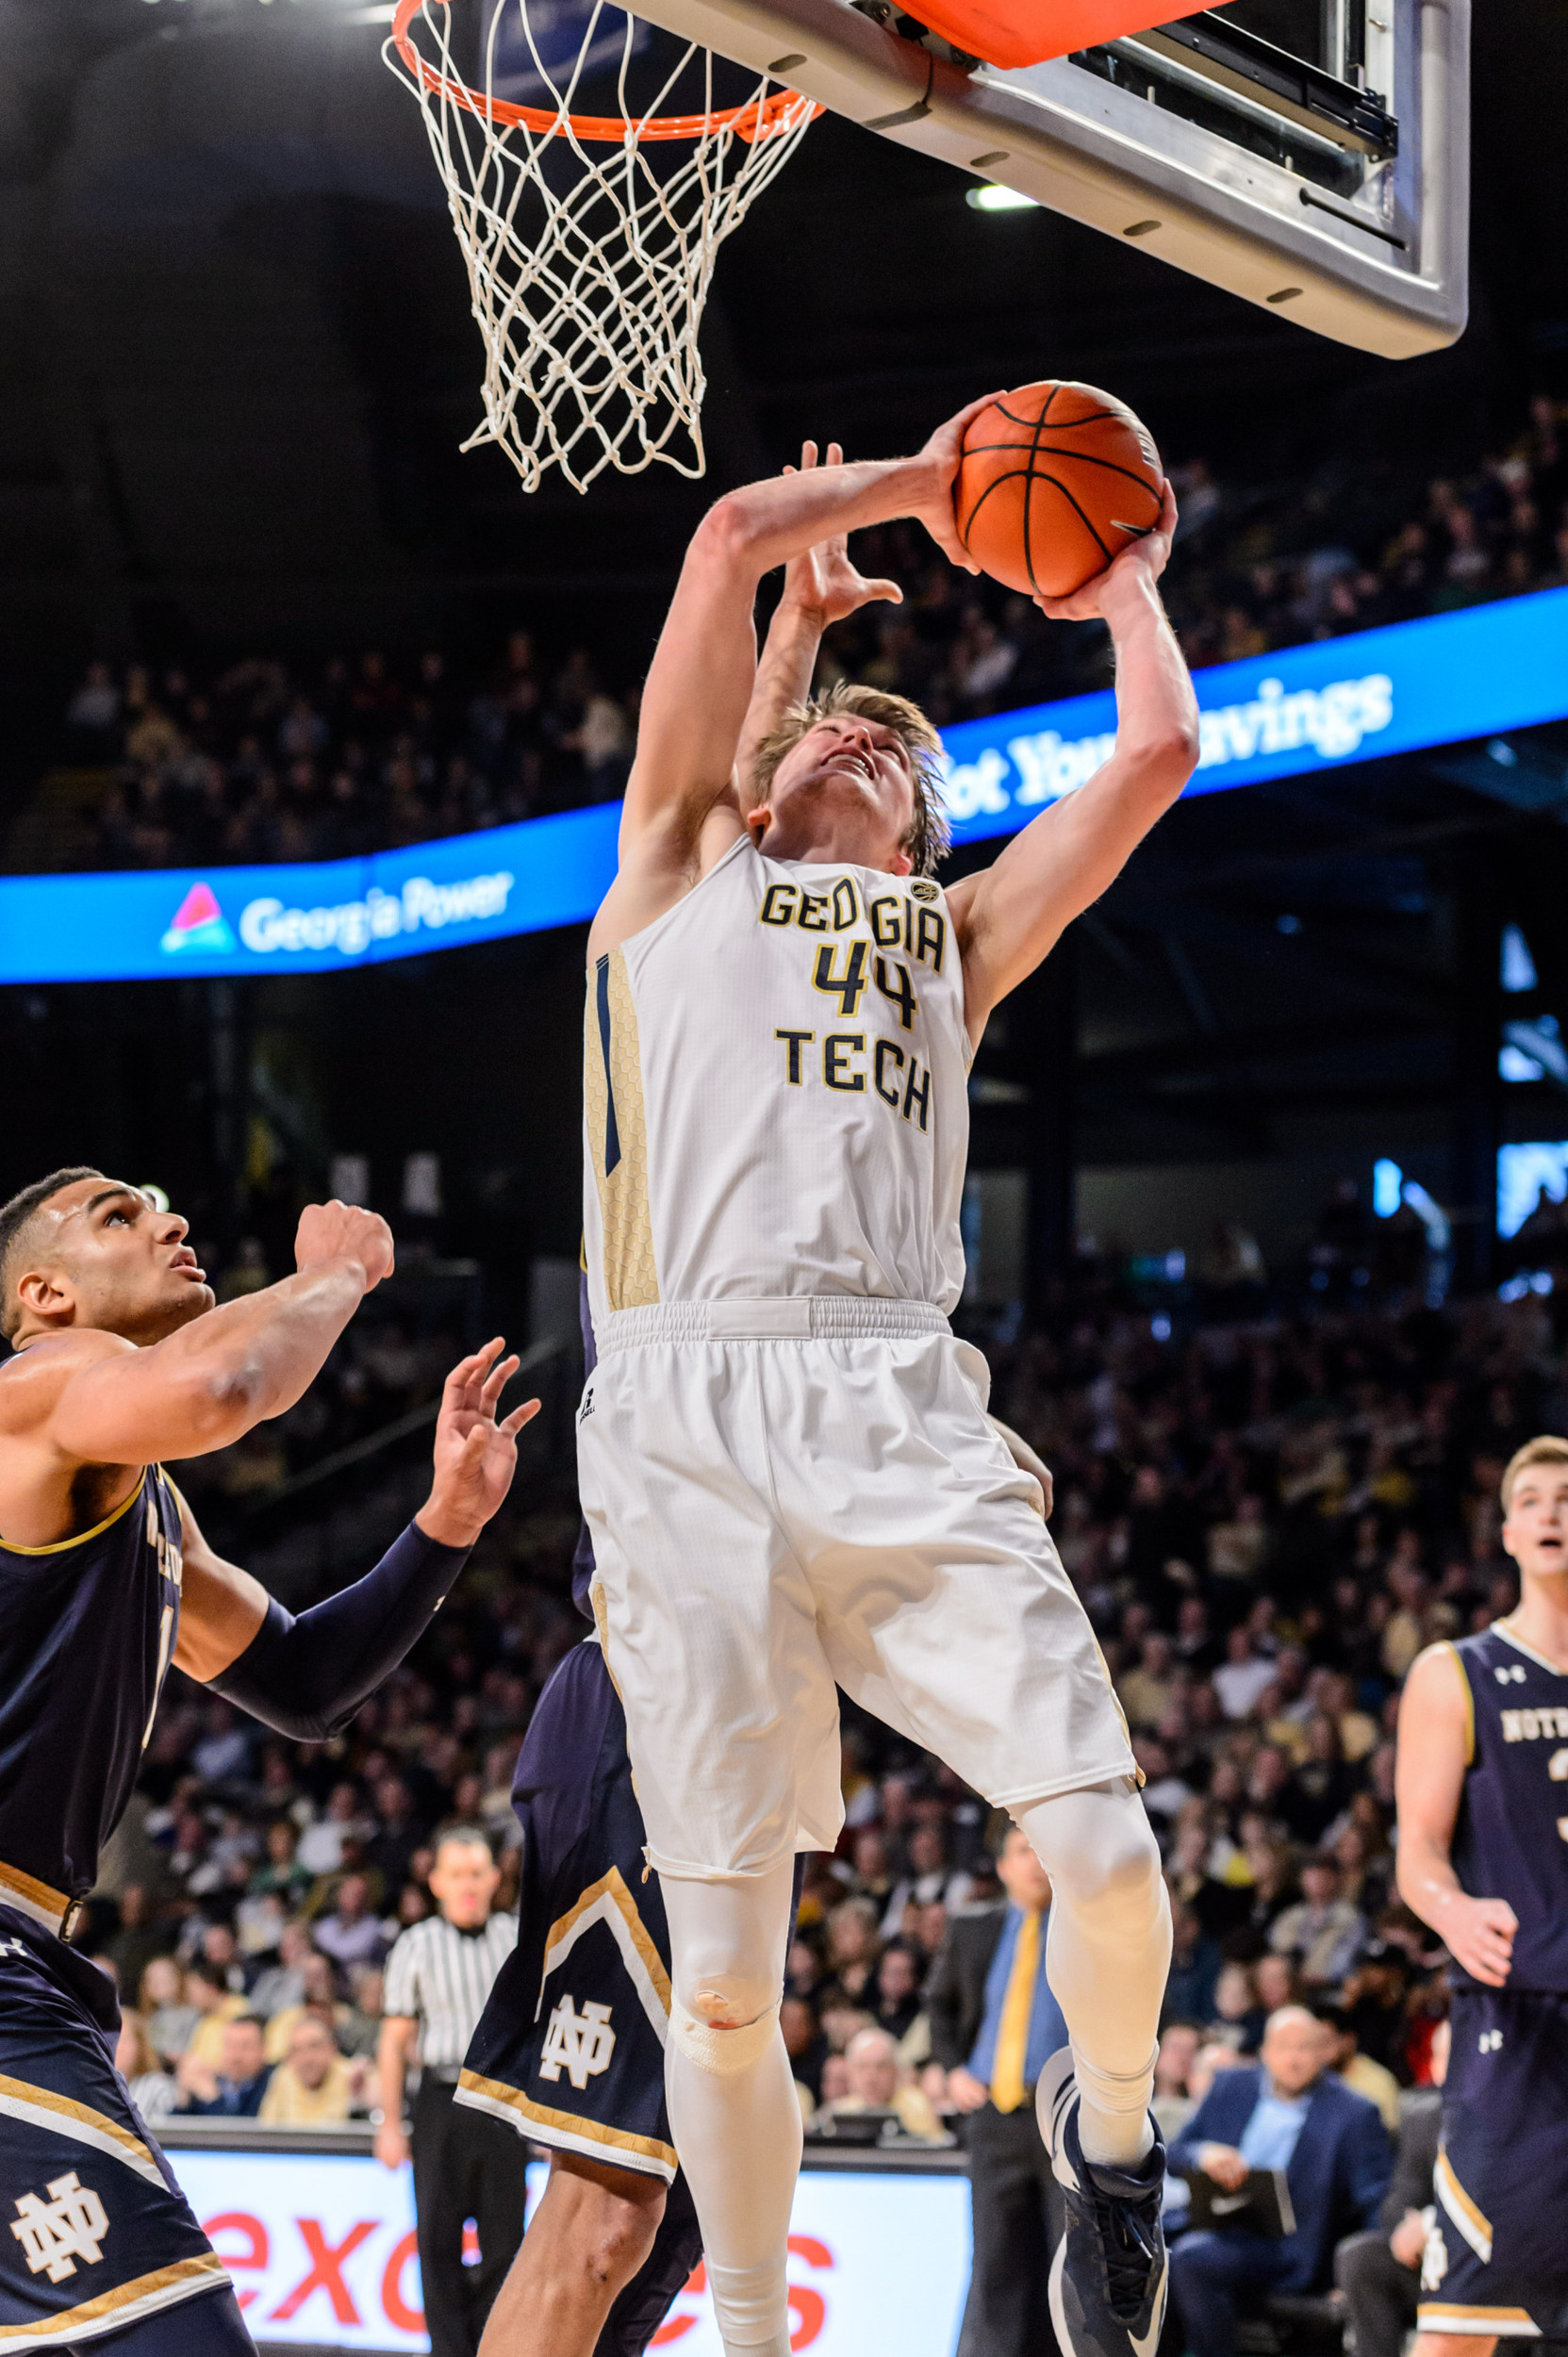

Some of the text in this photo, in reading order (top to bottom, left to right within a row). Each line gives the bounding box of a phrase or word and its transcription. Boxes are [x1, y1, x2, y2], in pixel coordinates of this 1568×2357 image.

[1197, 673, 1394, 770] avings
[239, 871, 515, 955] Georgia Power
[759, 876, 946, 977] GEOGIA
[812, 940, 919, 1033] 44
[774, 1029, 931, 1135] TECH
